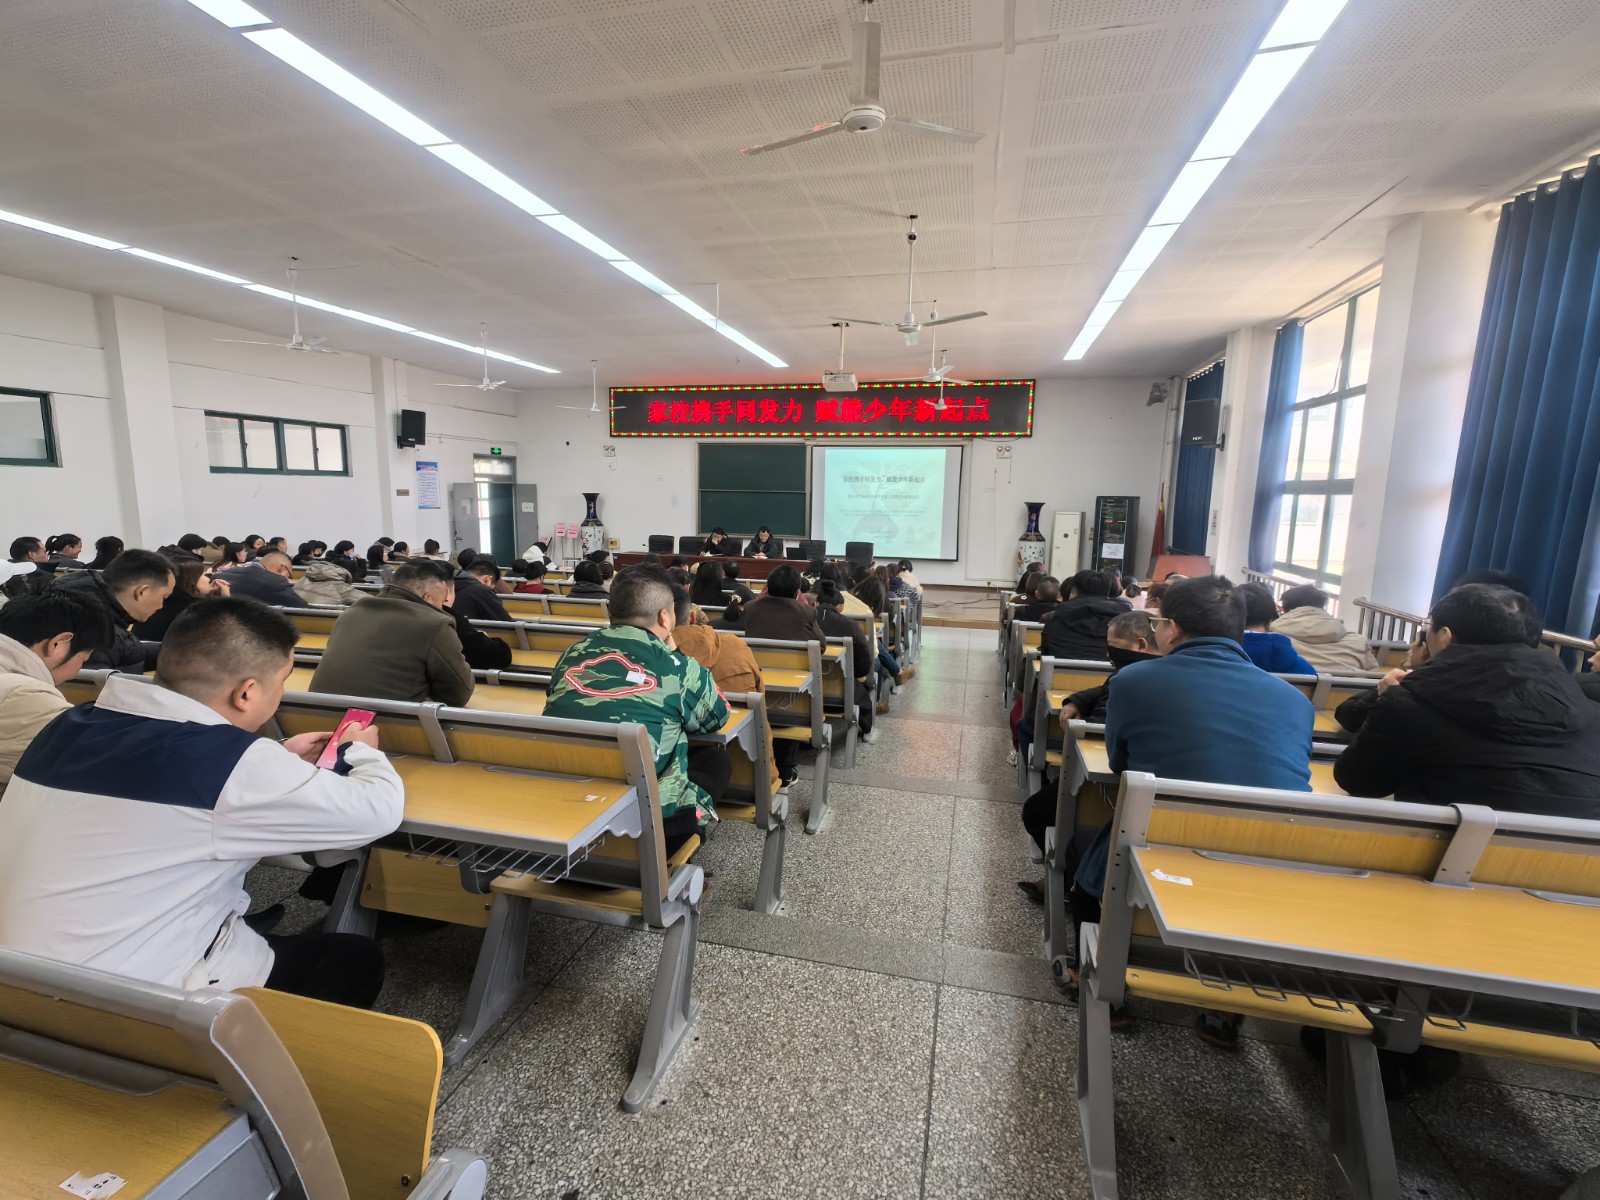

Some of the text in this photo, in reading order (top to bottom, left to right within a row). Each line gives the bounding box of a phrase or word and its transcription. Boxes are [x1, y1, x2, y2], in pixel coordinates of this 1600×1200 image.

[647, 396, 990, 424] 家校携手同发力 赋能少年新起点
